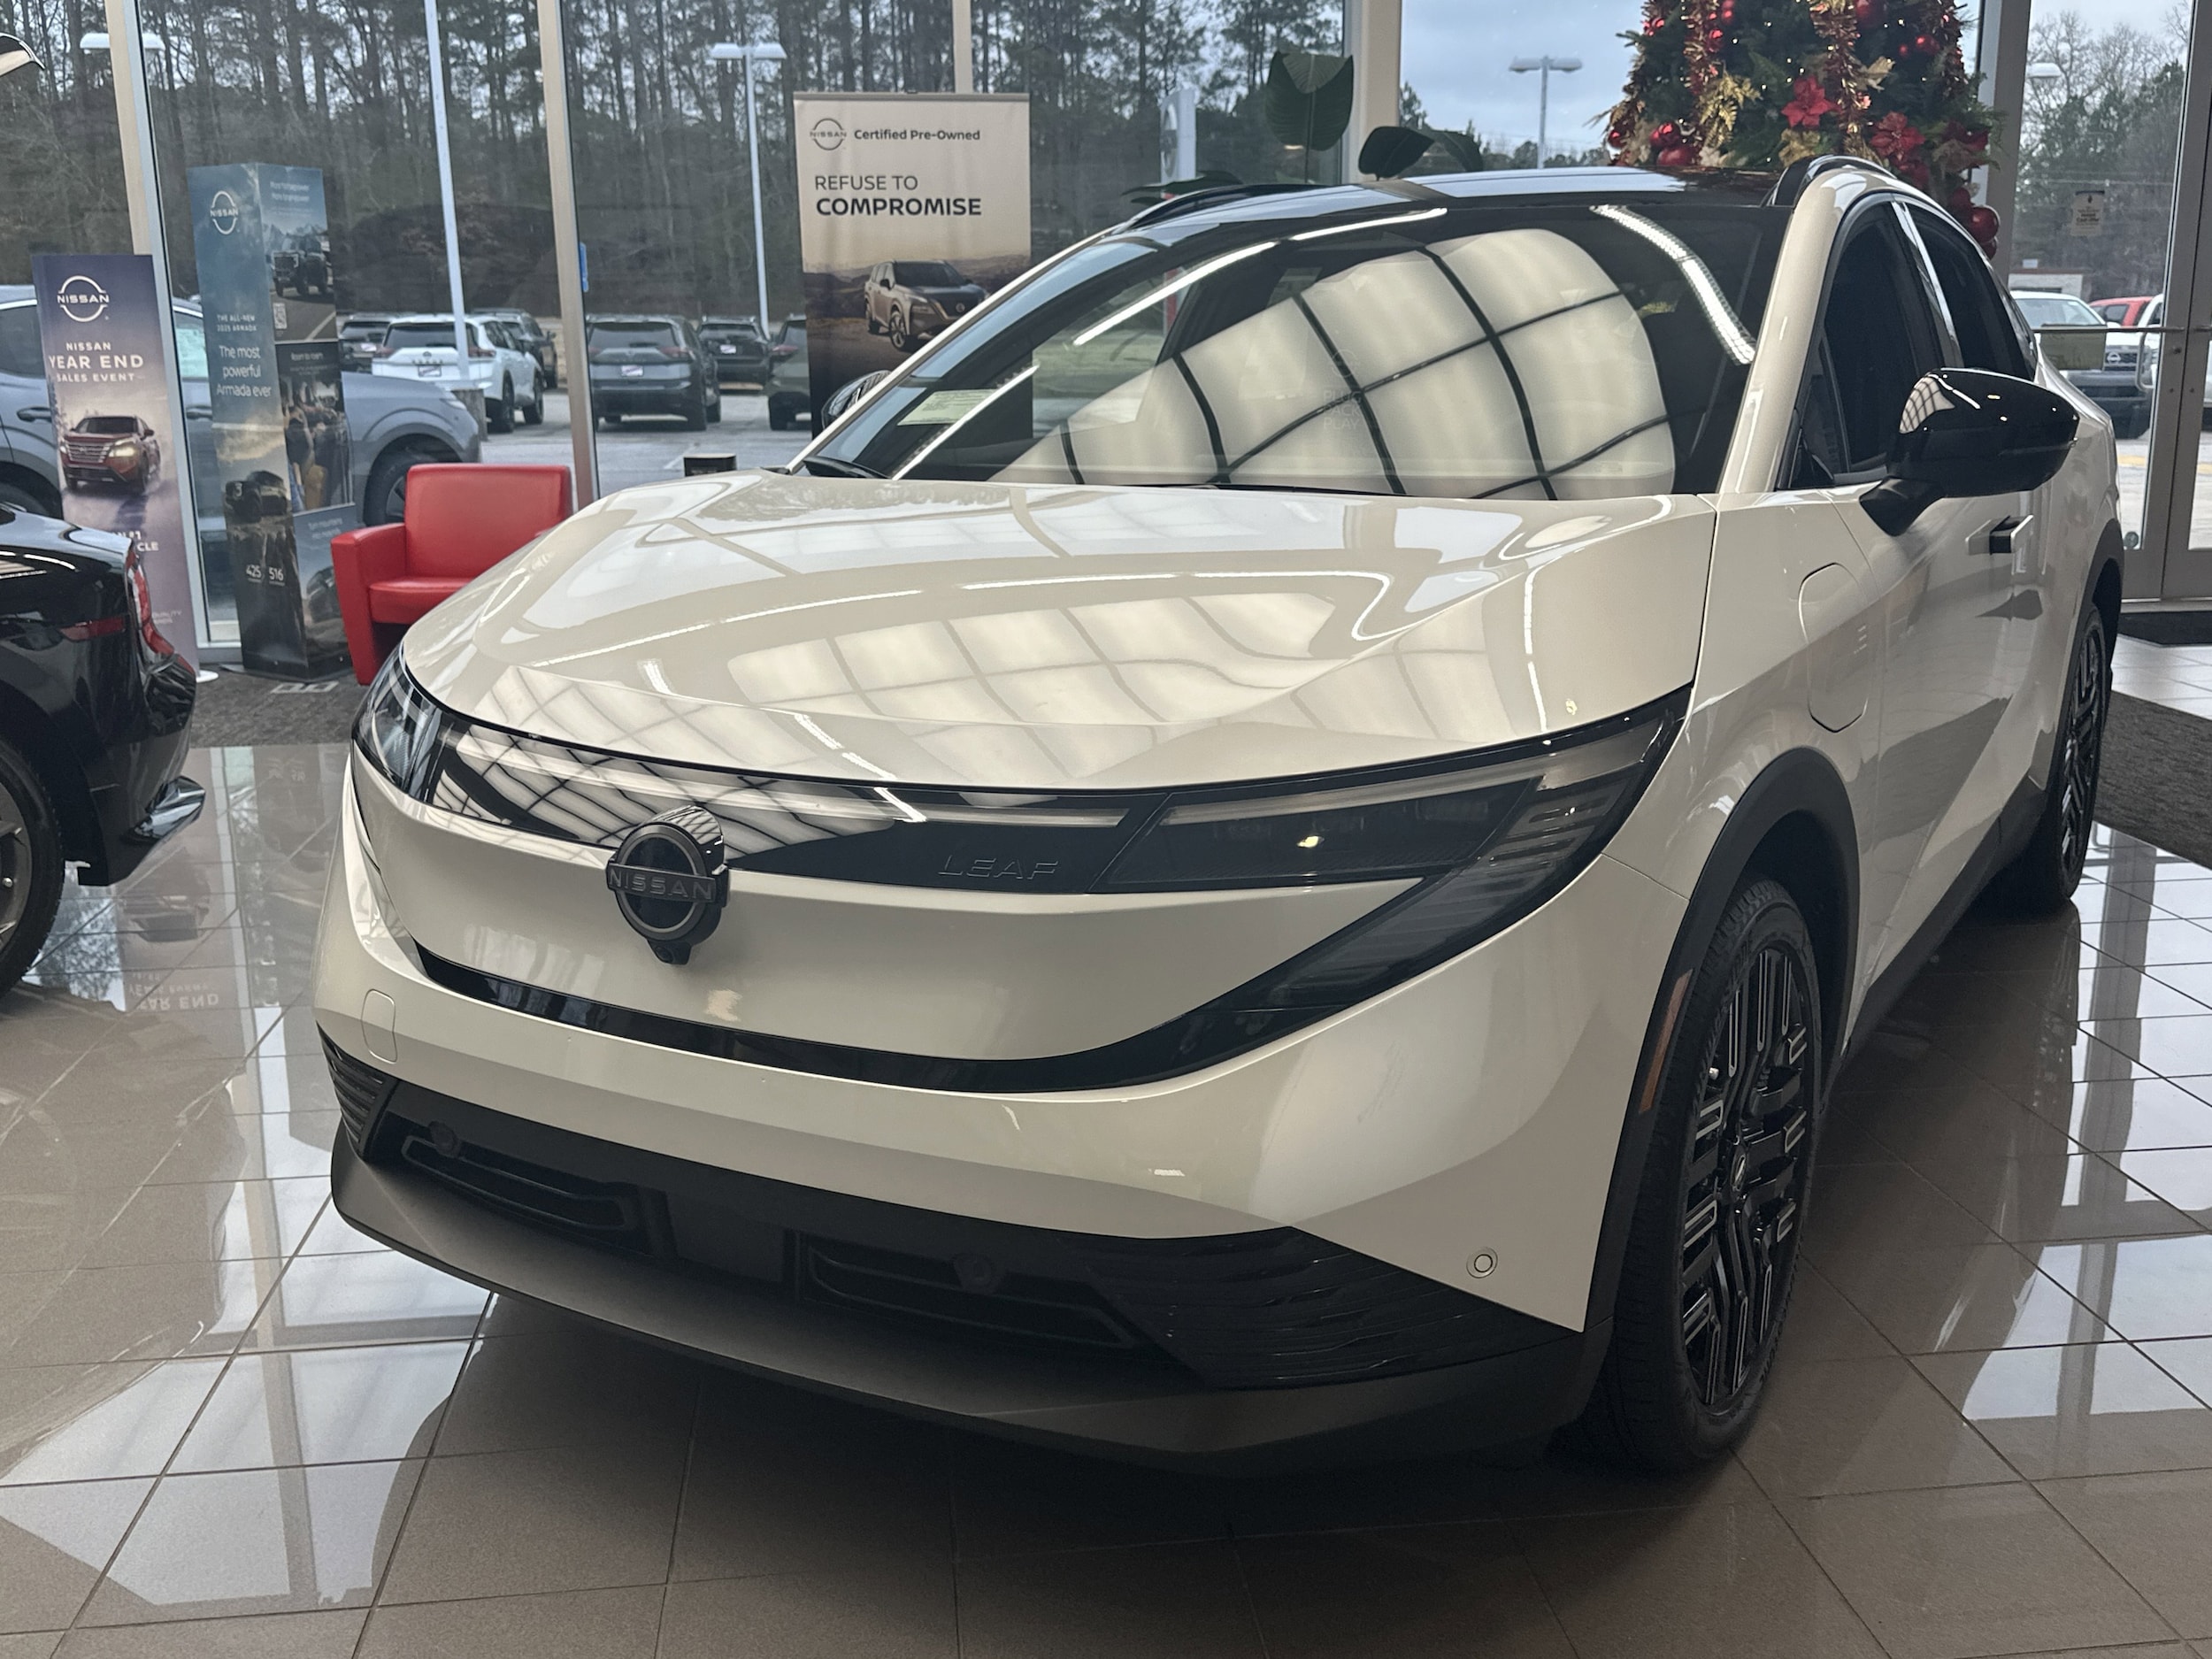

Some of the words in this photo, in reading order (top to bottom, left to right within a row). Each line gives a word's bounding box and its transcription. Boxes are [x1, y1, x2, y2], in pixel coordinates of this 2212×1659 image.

[853, 128, 907, 140] Certified
[910, 129, 980, 141] Pre-Owned
[815, 175, 887, 191] REFUSE
[891, 175, 918, 191] TO
[816, 196, 982, 216] COMPROMISE
[57, 294, 110, 303] NISSAN
[65, 342, 111, 351] NISSAN
[219, 344, 236, 359] The
[236, 346, 261, 359] most
[48, 355, 91, 370] YEAR
[99, 354, 144, 369] END
[56, 373, 88, 383] SALES
[92, 372, 134, 382] EVENT
[222, 363, 262, 380] powerful
[216, 383, 252, 397] Armada
[252, 386, 272, 398] ever
[246, 564, 262, 579] 425
[268, 566, 284, 581] 516
[937, 854, 1059, 880] LEAF
[609, 867, 712, 901] NISSAN
